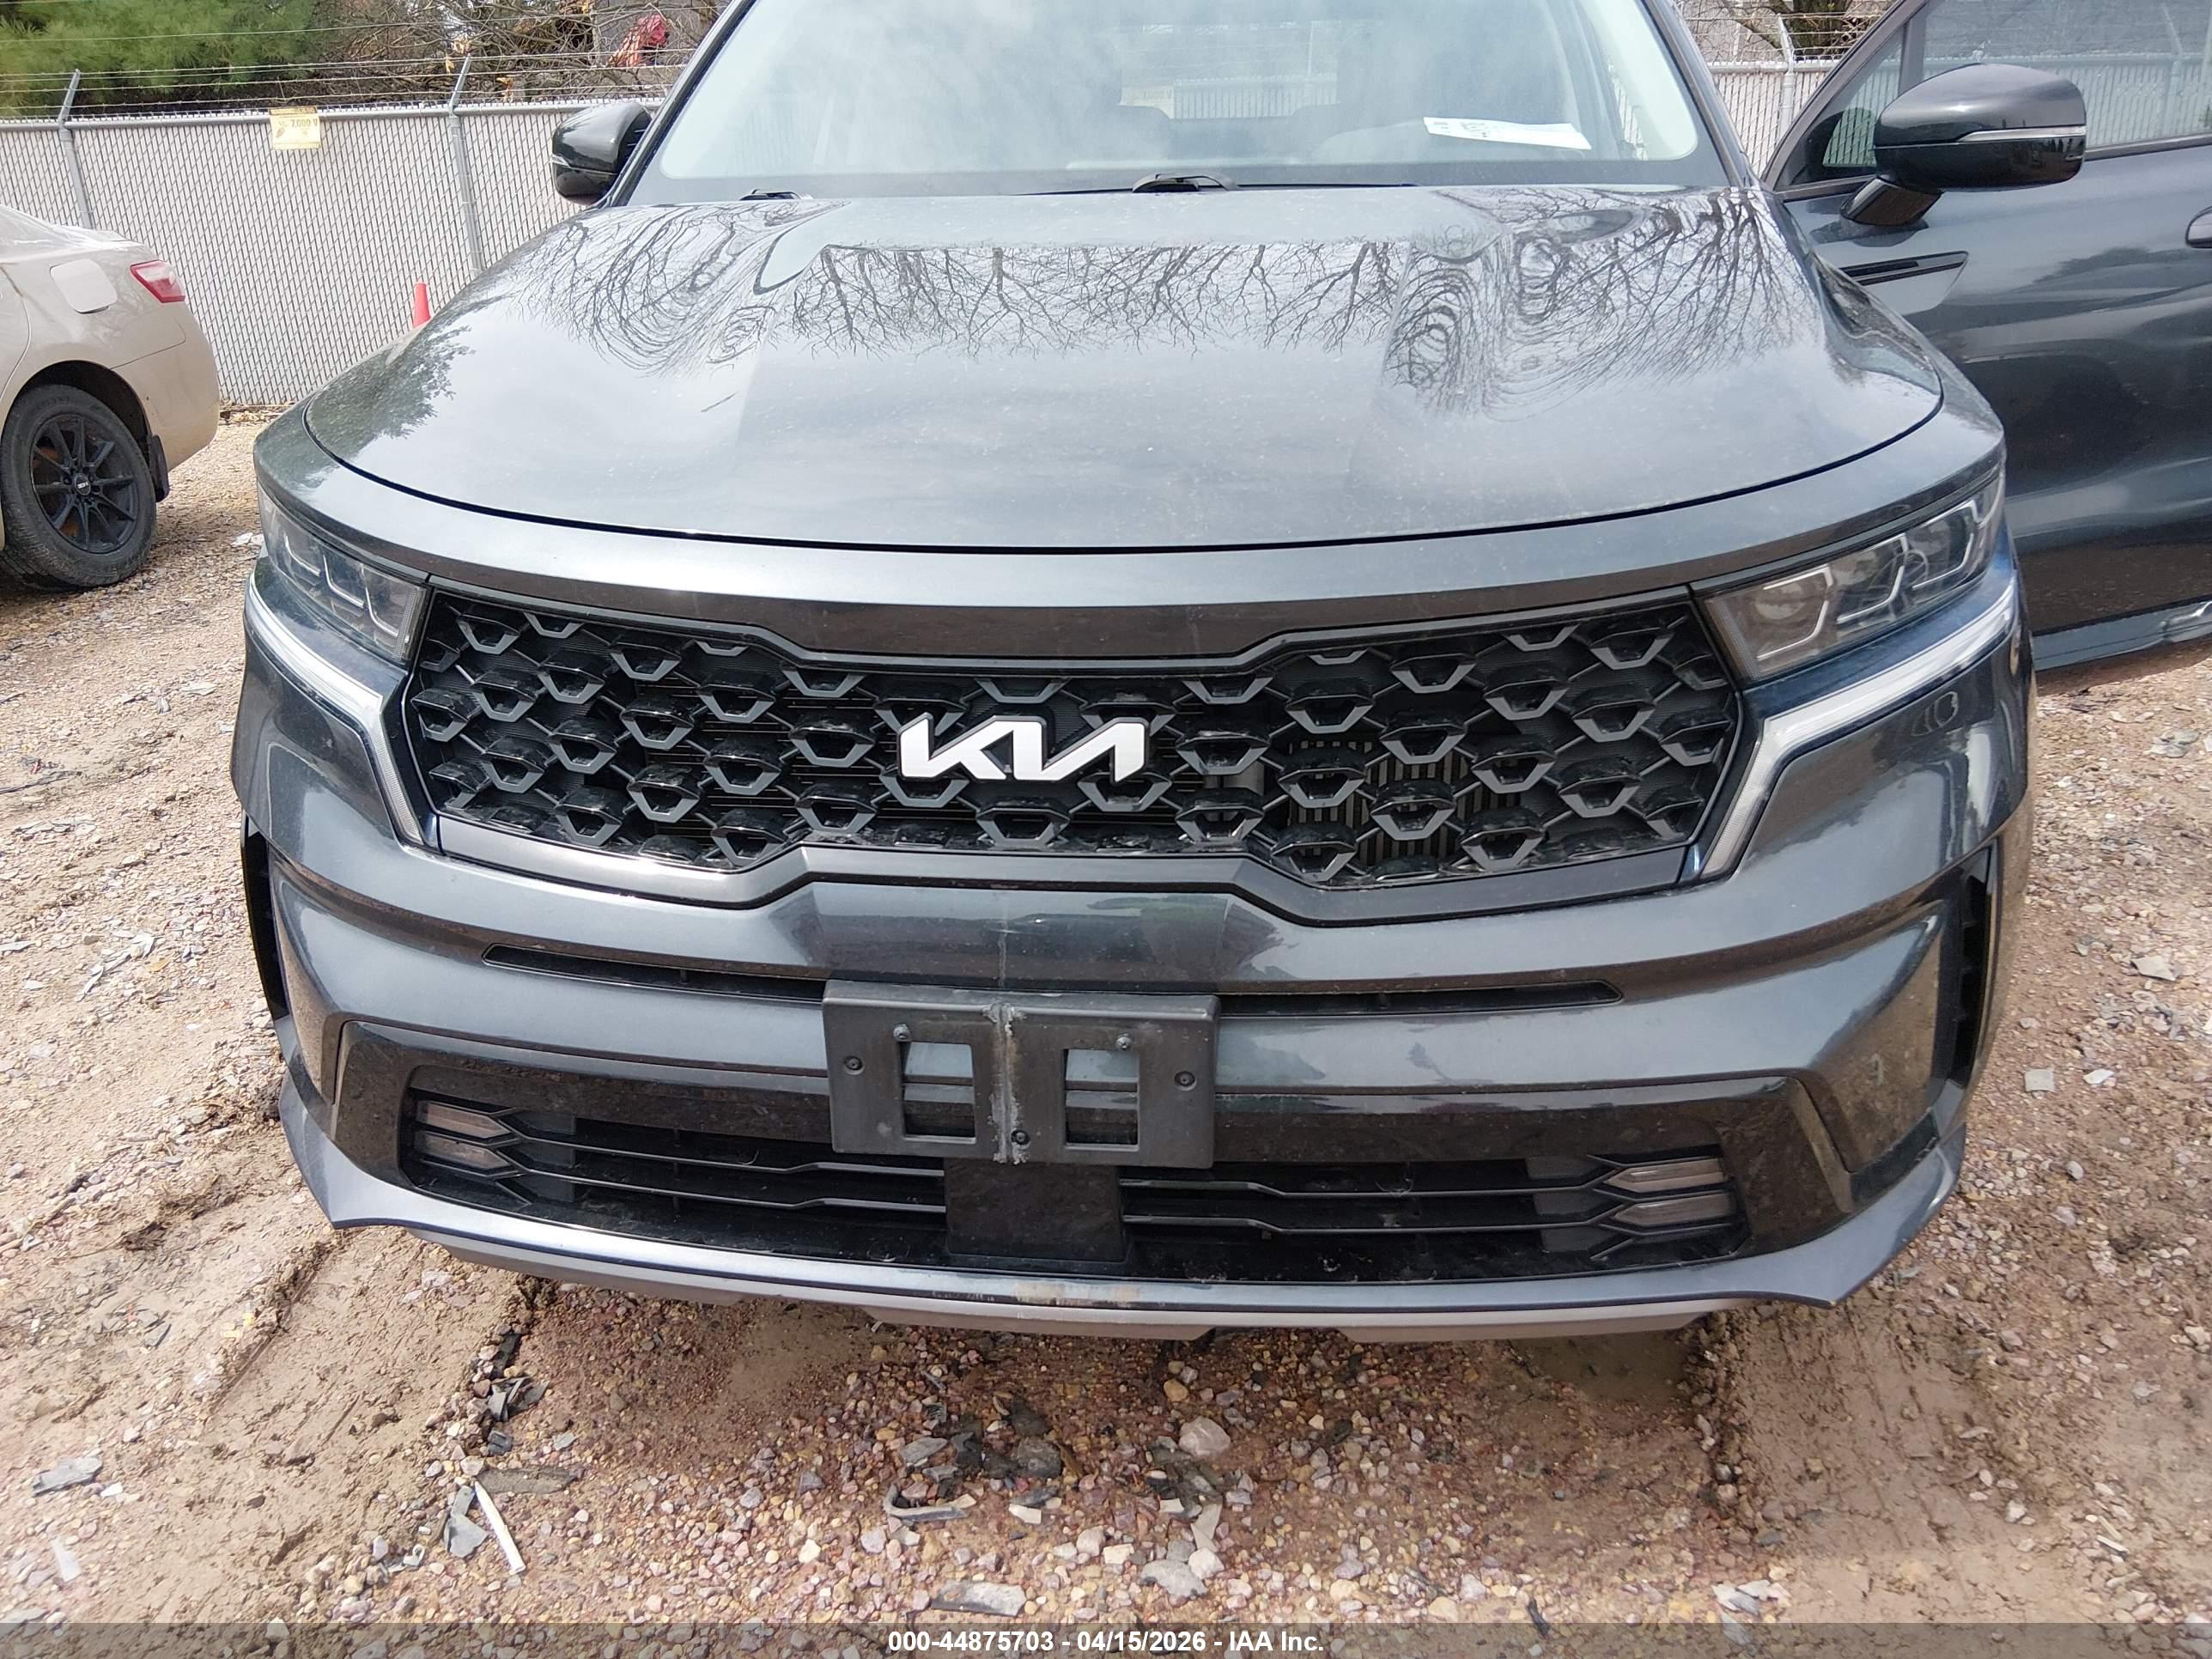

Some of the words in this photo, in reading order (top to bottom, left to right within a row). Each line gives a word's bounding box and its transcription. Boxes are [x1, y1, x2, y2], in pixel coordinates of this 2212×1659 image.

[289, 118, 311, 129] 7,000
[313, 118, 318, 127] V
[899, 714, 1146, 783] KIA
